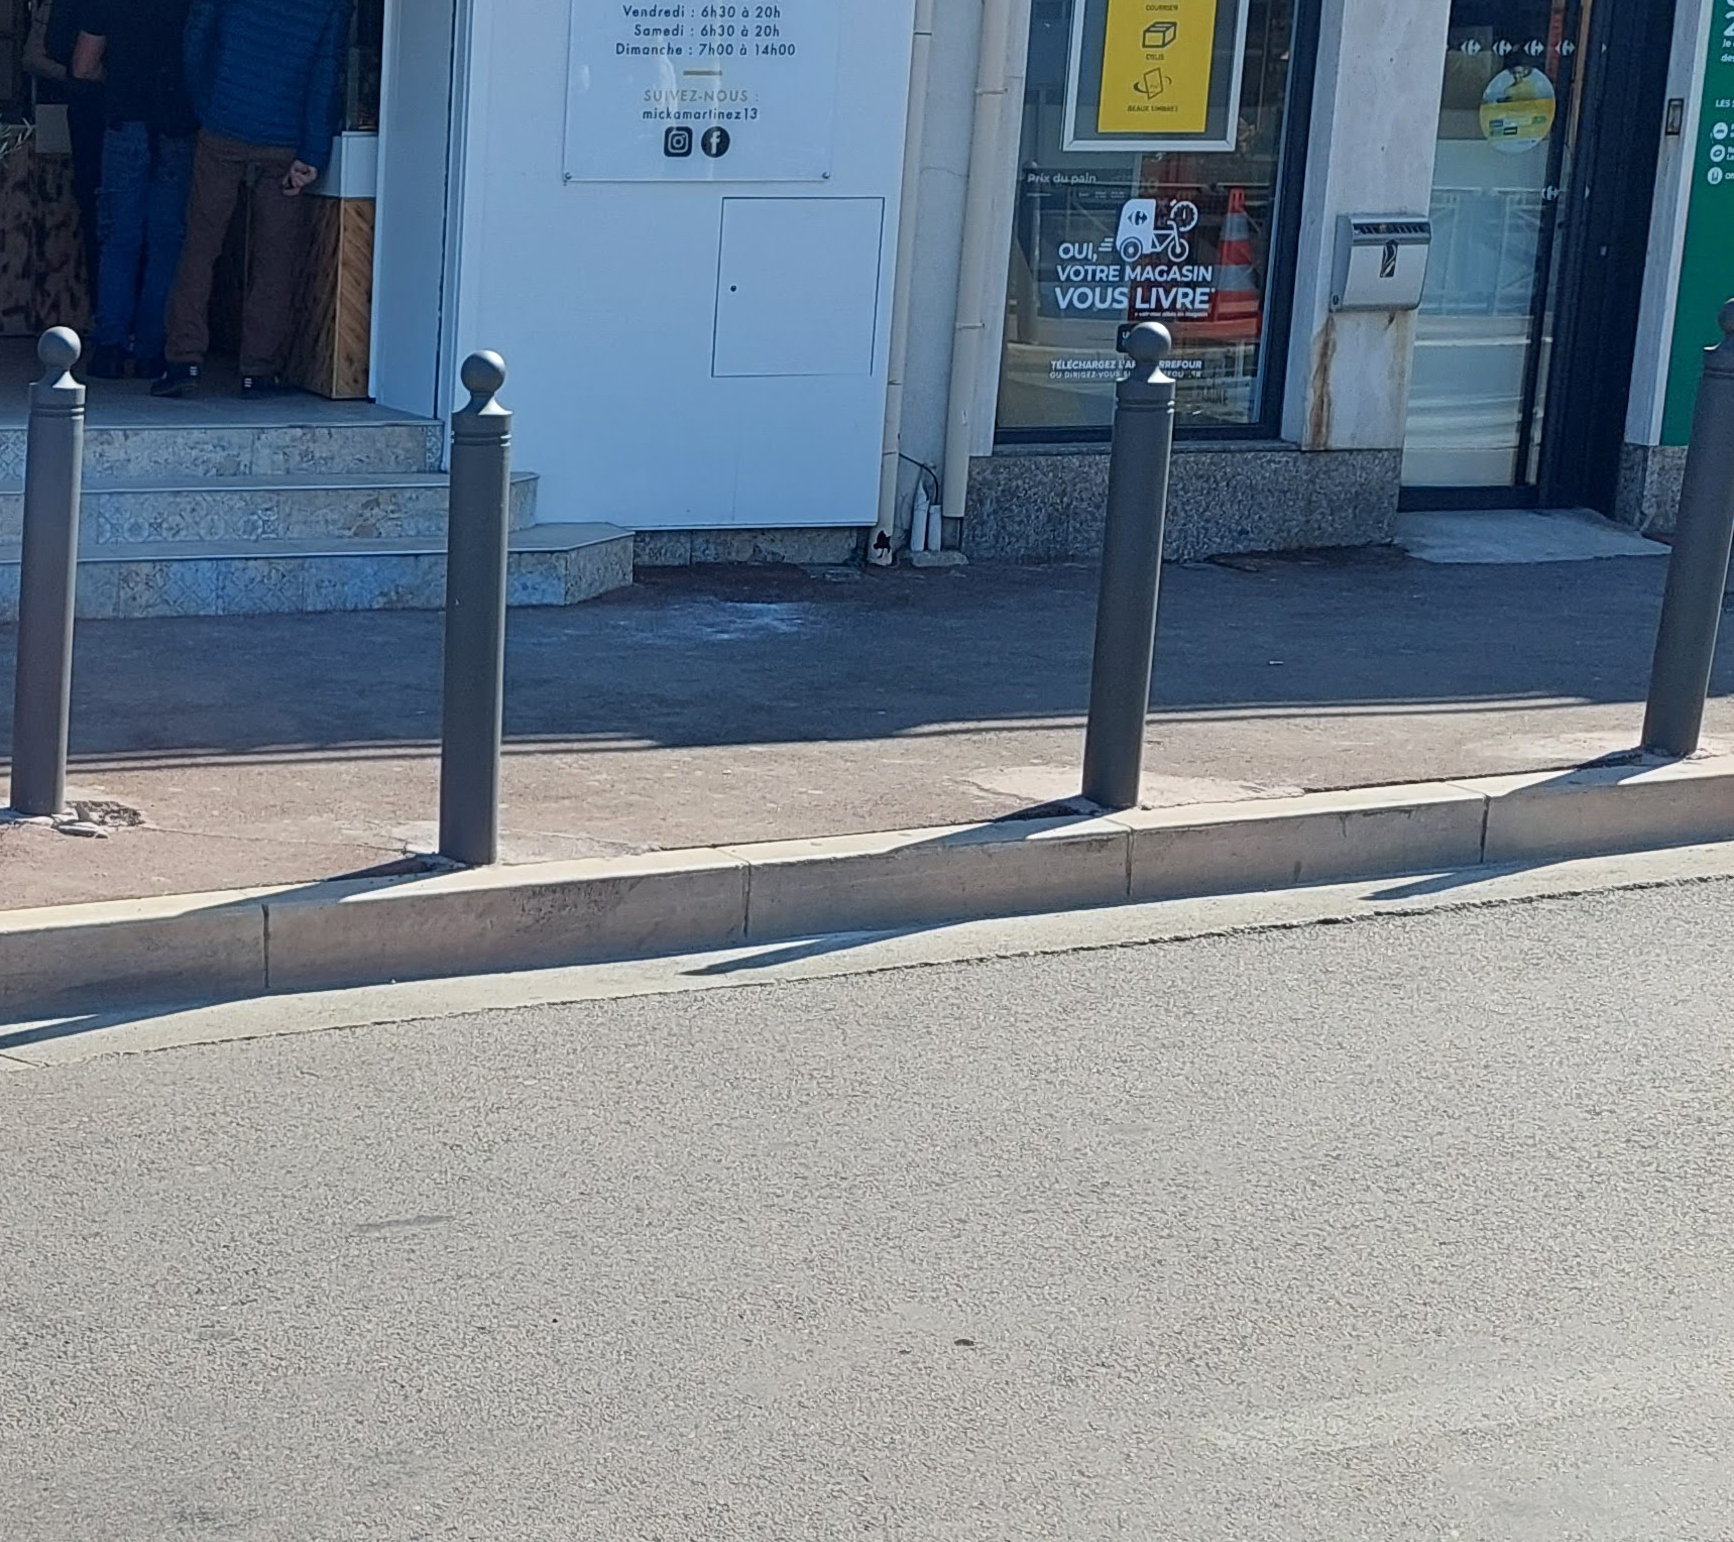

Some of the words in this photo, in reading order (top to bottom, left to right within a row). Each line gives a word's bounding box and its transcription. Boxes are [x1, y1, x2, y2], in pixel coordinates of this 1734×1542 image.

[623, 5, 685, 18] Vendredi
[701, 6, 736, 19] 6h30
[741, 6, 749, 19] à
[755, 6, 781, 19] 20h
[634, 24, 684, 37] Samedi
[700, 25, 735, 38] 6h30
[741, 25, 749, 38] à
[754, 25, 780, 38] 20h
[615, 43, 683, 56] Dimanche
[698, 44, 734, 56] 7h00
[740, 44, 747, 56] à
[754, 44, 796, 57] 14h00
[643, 90, 749, 102] SUIVEZ-NOUS
[642, 108, 758, 121] mickamartinez13
[1027, 172, 1050, 183] Prix
[1053, 172, 1067, 183] du
[1071, 172, 1097, 185] pain
[1058, 242, 1098, 262] OUI,
[1056, 265, 1121, 282] VOTRE
[1124, 265, 1213, 282] MAGASIN
[1055, 287, 1129, 310] VOUS
[1050, 359, 1116, 370] TÉLÉCHARGEZ
